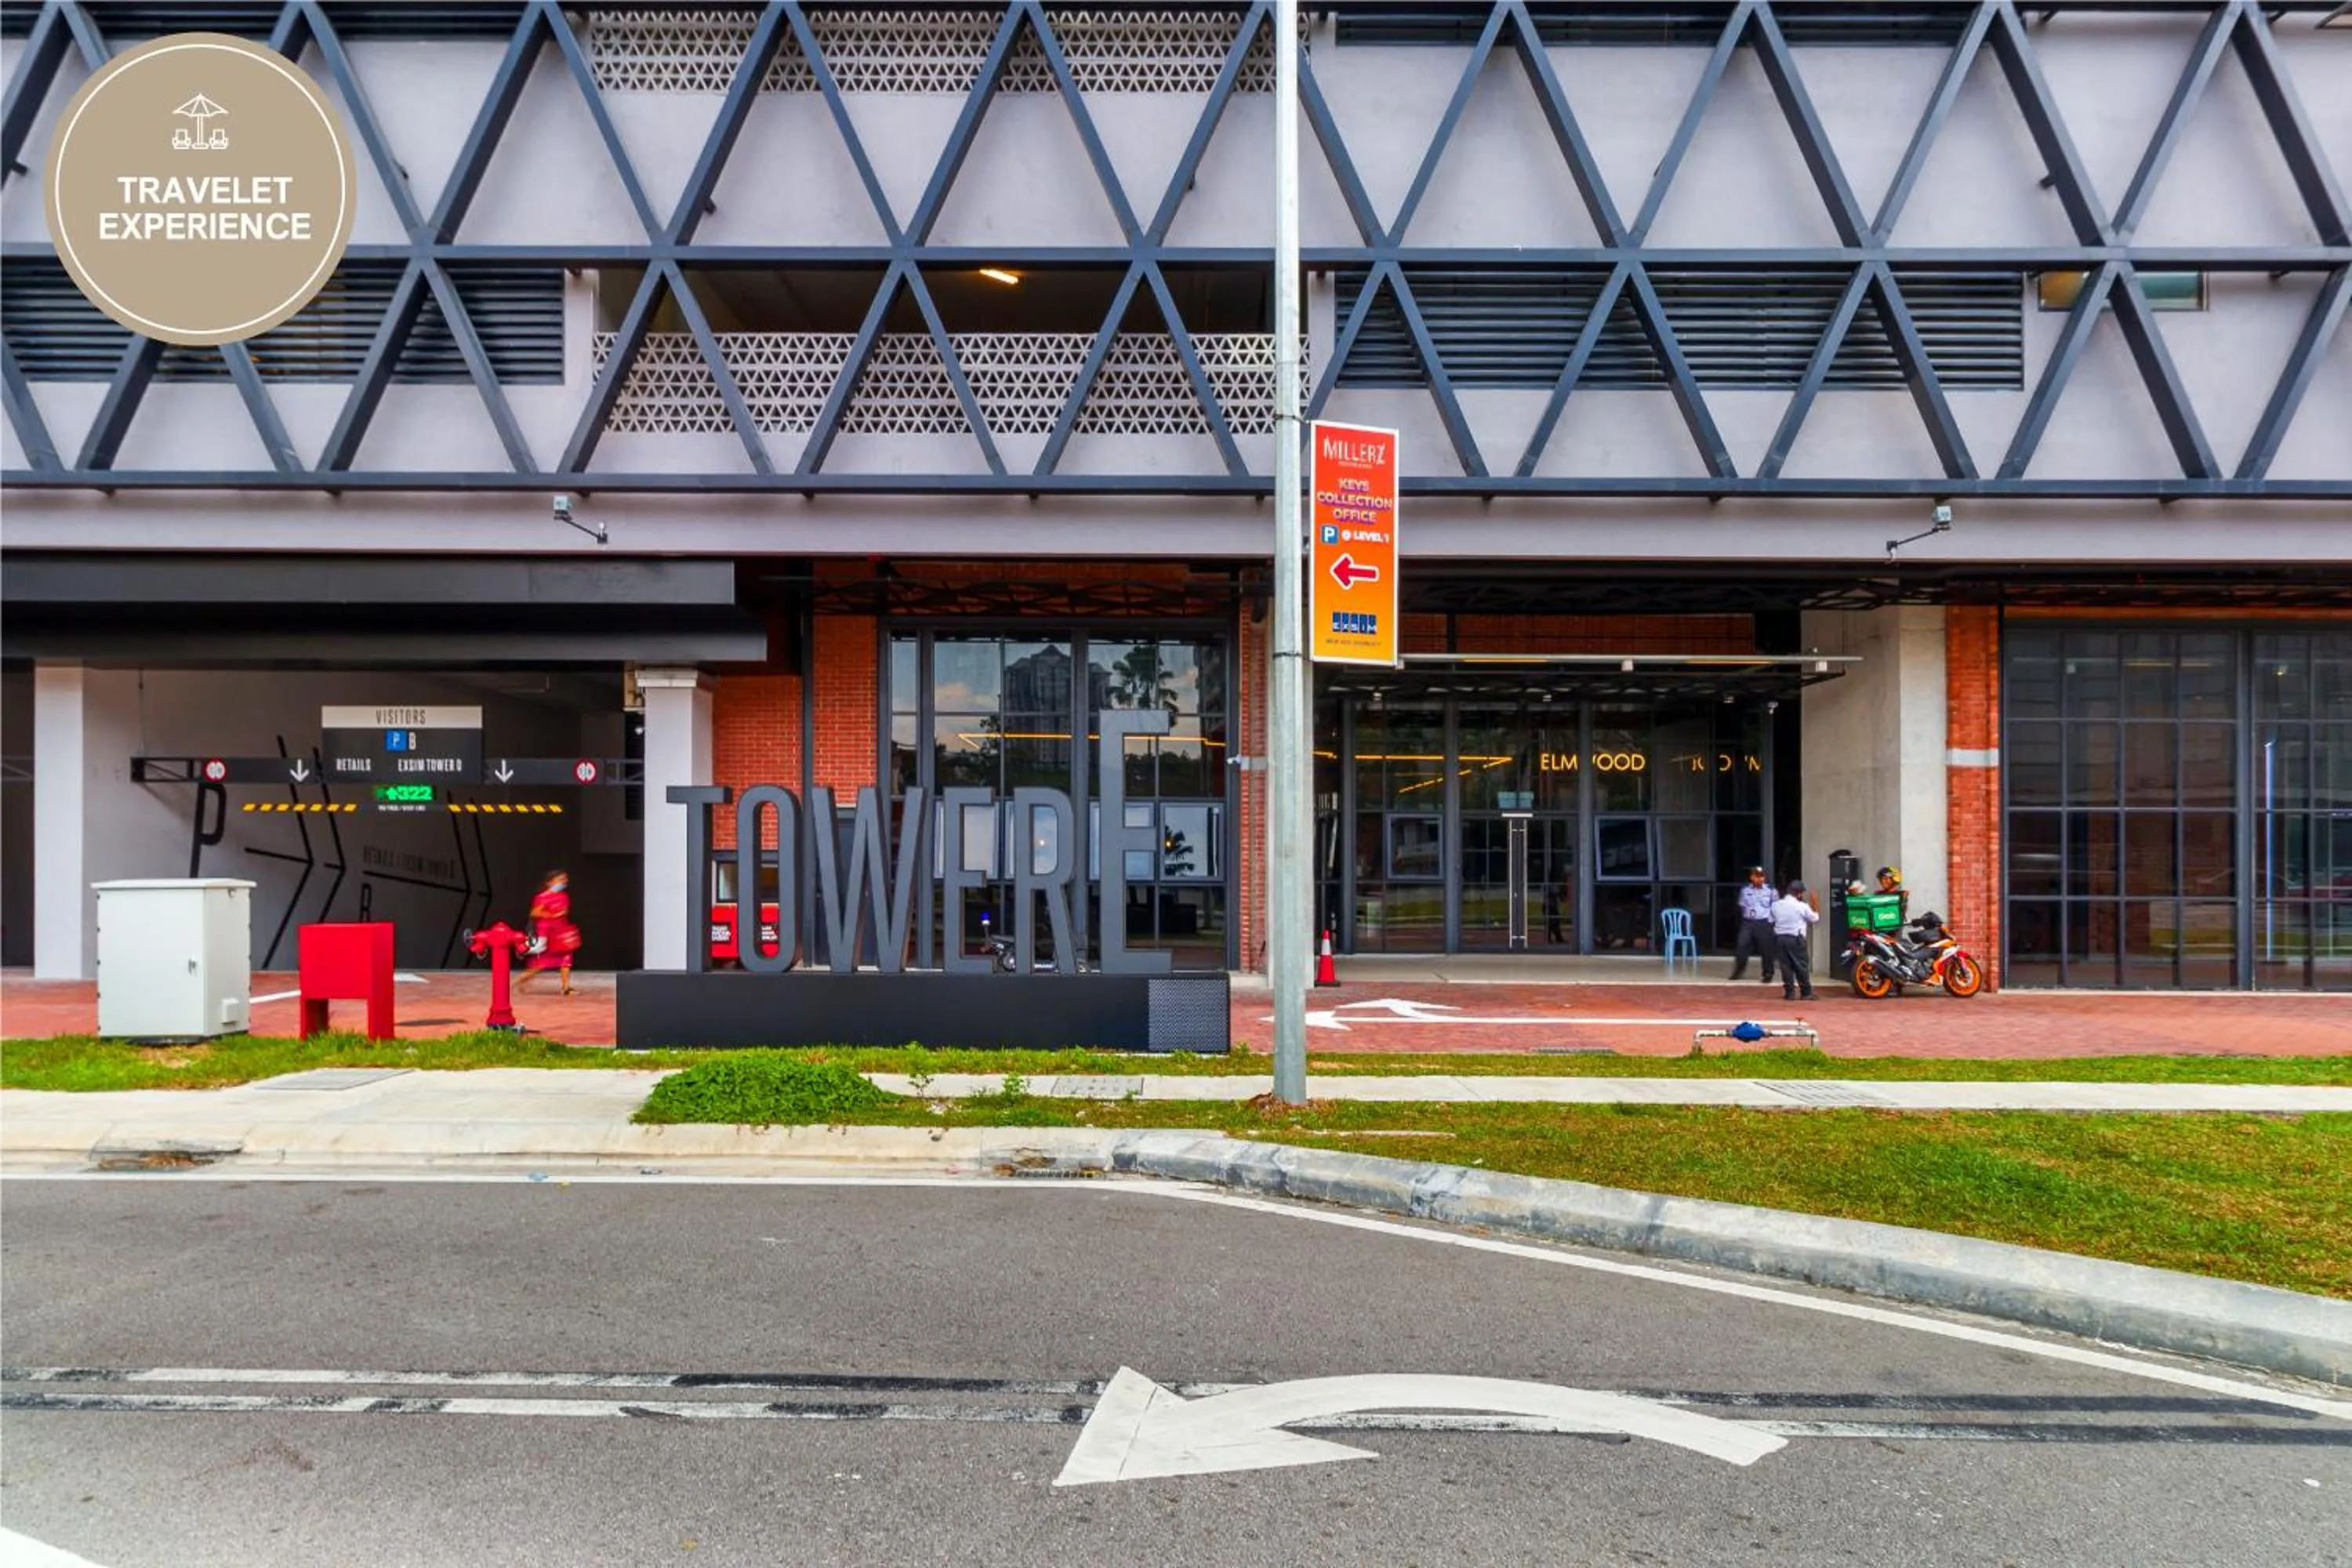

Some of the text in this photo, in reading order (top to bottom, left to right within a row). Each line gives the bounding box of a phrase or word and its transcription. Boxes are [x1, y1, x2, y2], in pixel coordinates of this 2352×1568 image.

[1323, 435, 1386, 465] MILLERZ
[1338, 478, 1369, 491] KEYS
[1316, 491, 1392, 509] COLLECTION
[1333, 507, 1377, 523] OFFICE
[1323, 526, 1335, 543] P
[1354, 531, 1383, 543] LEVEL
[376, 709, 426, 725] VISITORS
[336, 757, 372, 771] RETAILS
[397, 758, 425, 772] EXSIM
[426, 758, 455, 772] TOWER
[1540, 753, 1646, 771] ELMOOD
[397, 786, 432, 800] 322
[666, 709, 1173, 974] TOWER E
